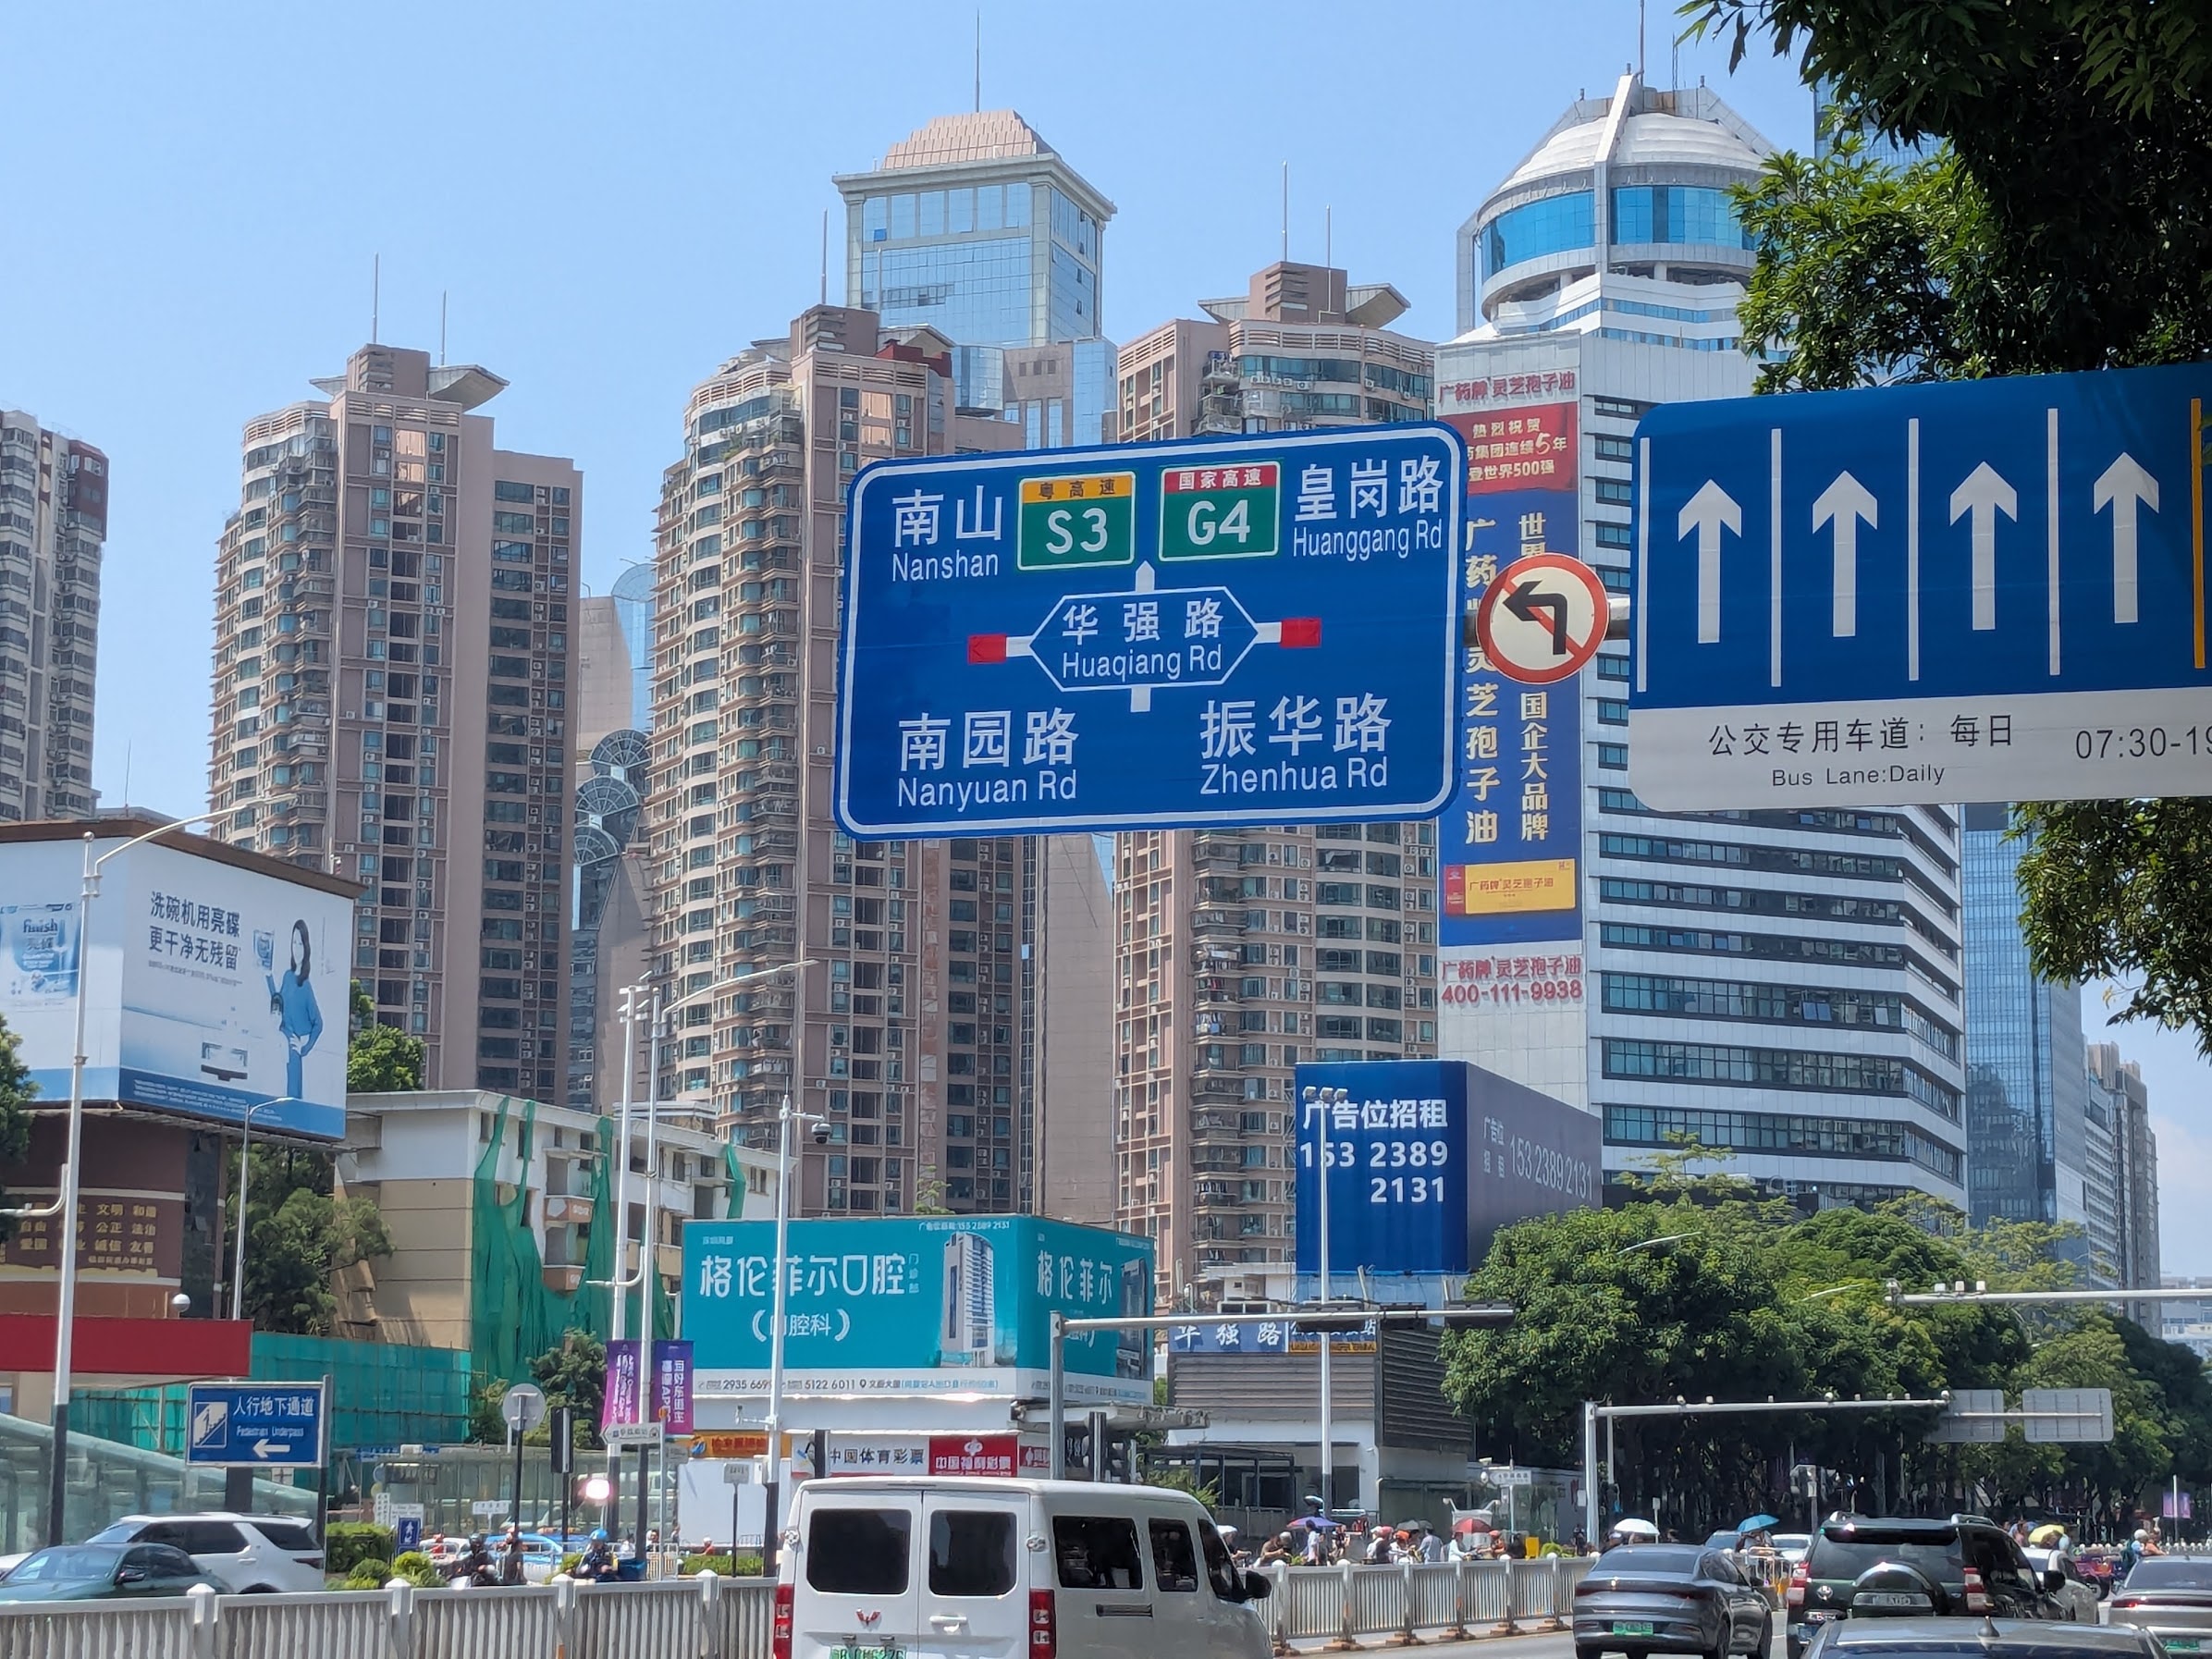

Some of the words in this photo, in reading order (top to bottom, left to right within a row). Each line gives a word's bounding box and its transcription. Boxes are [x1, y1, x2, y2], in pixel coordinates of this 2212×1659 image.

[1038, 478, 1116, 500] 粤高速
[1178, 468, 1262, 490] 国家高速
[1296, 455, 1444, 521] 皇岗路
[891, 485, 1003, 548] 南山
[1046, 508, 1108, 555] S3
[1187, 499, 1250, 546] G4
[1295, 524, 1409, 561] Huanggang
[1416, 519, 1442, 550] Rd
[892, 551, 999, 582] Nanshan
[1063, 597, 1224, 645] 华强路
[1063, 648, 1182, 682] Huaqiang
[1189, 644, 1222, 671] Rd
[899, 707, 1080, 772] 南园路
[1200, 692, 1393, 760] 振华路
[1950, 714, 2014, 748] 每日
[898, 771, 1026, 812] Nanyuan
[1038, 770, 1077, 801] Rd
[1200, 762, 1337, 795] Zhenhua
[1347, 756, 1388, 789] Rd
[1772, 768, 1813, 788] Bus
[1826, 764, 1946, 787] Lane:Daily
[151, 891, 240, 938] 洗碗机用亮碟
[149, 925, 239, 971] 更干净无残留
[1303, 1099, 1448, 1130] 广告位招租
[1370, 1140, 1448, 1168] 2389
[1370, 1177, 1444, 1203] 2131
[1037, 1249, 1113, 1306] 格伦菲尔
[233, 1395, 314, 1417] 人行地下通道
[829, 1447, 925, 1465] 中国体育彩票
